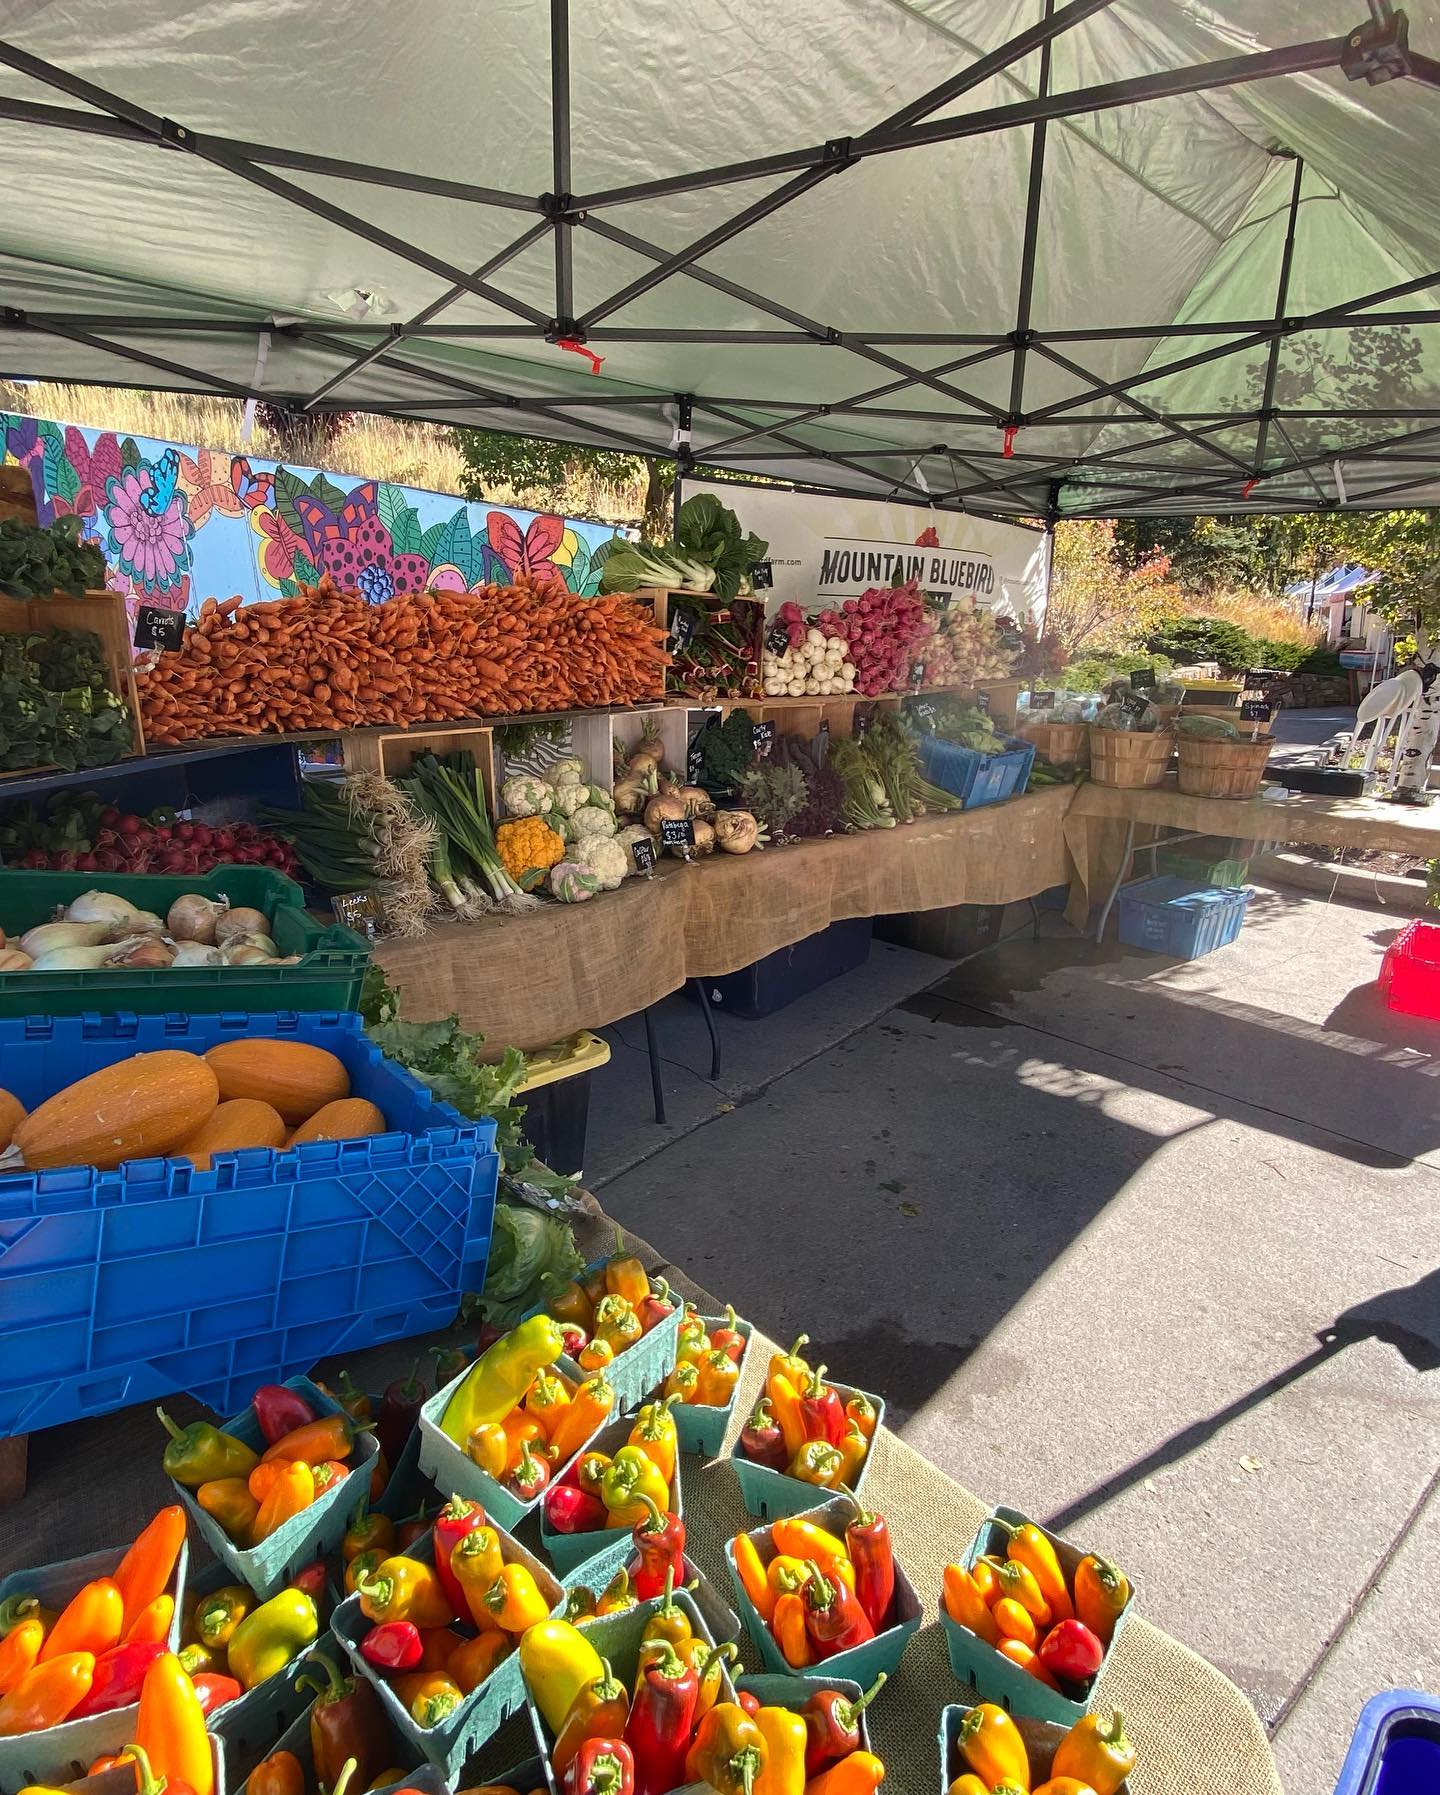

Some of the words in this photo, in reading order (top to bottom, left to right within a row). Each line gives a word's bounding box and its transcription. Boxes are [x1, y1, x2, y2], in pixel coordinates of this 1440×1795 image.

[819, 550, 924, 585] MOUNTAIN
[930, 558, 994, 594] BLUEBIRD
[146, 611, 175, 625] Carrots
[151, 625, 166, 637] $5
[342, 895, 368, 908] Leeks
[346, 909, 362, 922] $5
